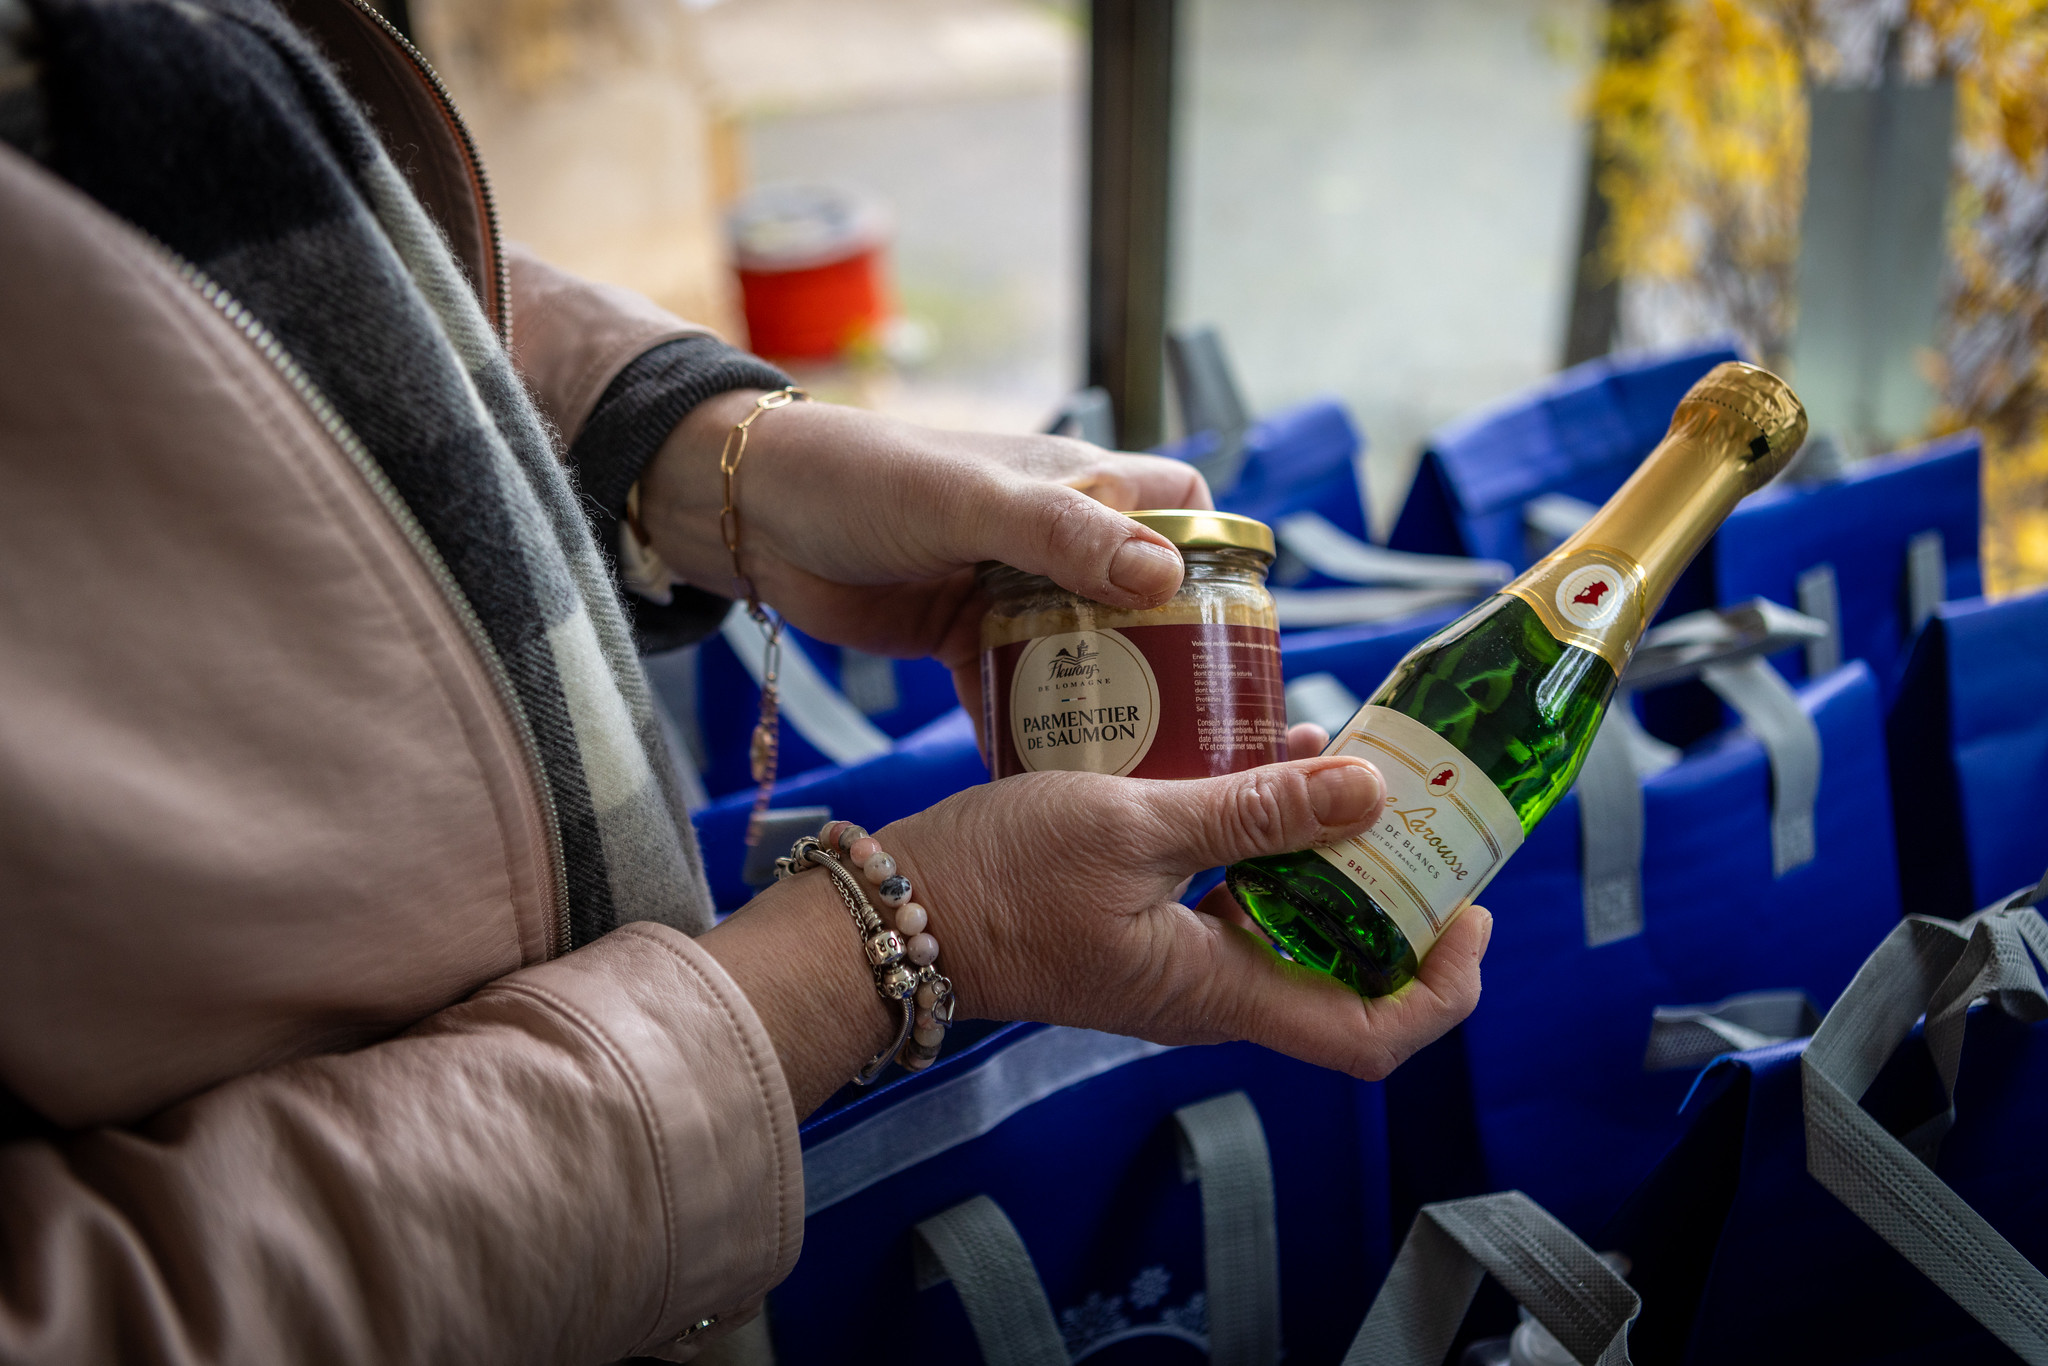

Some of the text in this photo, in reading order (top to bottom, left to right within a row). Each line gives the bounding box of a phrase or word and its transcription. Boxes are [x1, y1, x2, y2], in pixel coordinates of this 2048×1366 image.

[1047, 660, 1100, 681] Fleurons
[1055, 678, 1111, 690] LOMAGNE
[1023, 705, 1140, 734] PARMENTIER
[1028, 723, 1135, 750] DE SAUMON
[1198, 735, 1211, 743] date
[1385, 824, 1441, 879] DE BLANCS
[1385, 841, 1393, 850] DE
[1394, 850, 1418, 873] FRANCE
[1393, 807, 1469, 881] Larousse
[1347, 859, 1378, 886] BRUT
